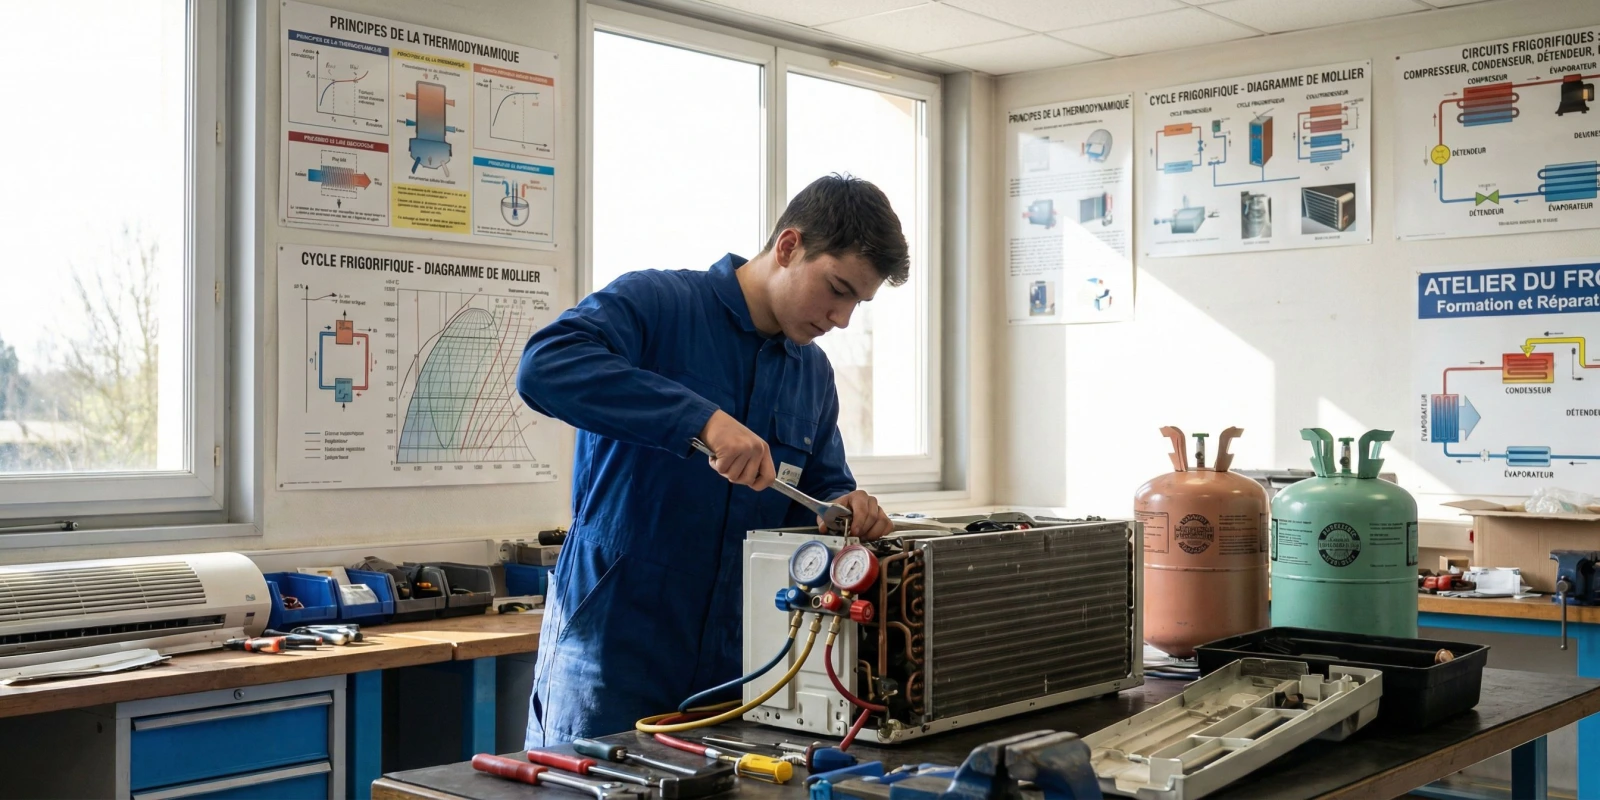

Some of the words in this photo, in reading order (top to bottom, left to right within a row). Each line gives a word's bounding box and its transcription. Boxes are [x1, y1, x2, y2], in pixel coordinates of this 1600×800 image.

[330, 16, 388, 38] PRINCIPES
[390, 26, 404, 41] DE
[407, 30, 420, 44] LA
[423, 33, 520, 63] THERMODYNAMIQUE
[1462, 43, 1509, 59] CIRCUITS
[1512, 31, 1594, 54] FRIGORIFIQUES
[1403, 63, 1469, 80] COMPRESSEUR,
[1472, 54, 1535, 72] CONDENSEUR,
[1537, 48, 1595, 63] DÉTENDEUR,
[1149, 90, 1176, 106] CYCLE
[1178, 84, 1239, 102] FRIGORIFIQUE
[1247, 75, 1304, 94] DIAGRAMME
[1306, 74, 1320, 85] DE
[1321, 67, 1364, 83] MOLLIER
[1043, 109, 1051, 119] DE
[1052, 108, 1061, 118] LA
[1062, 99, 1130, 116] THERMODYNAMIQUE
[1452, 147, 1486, 157] DÉTENDEUR
[1469, 207, 1504, 217] DÉTENDEUR
[301, 251, 337, 268] CYCLE
[340, 254, 414, 274] FRIGORIFIQUE
[424, 262, 484, 279] DIAGRAMME
[486, 264, 499, 280] DE
[501, 268, 540, 283] MOLLIER
[1424, 273, 1517, 296] ATELIER
[1524, 271, 1555, 291] DU
[1437, 298, 1513, 314] Formation
[1518, 297, 1532, 309] et
[1537, 293, 1600, 311] Réparat
